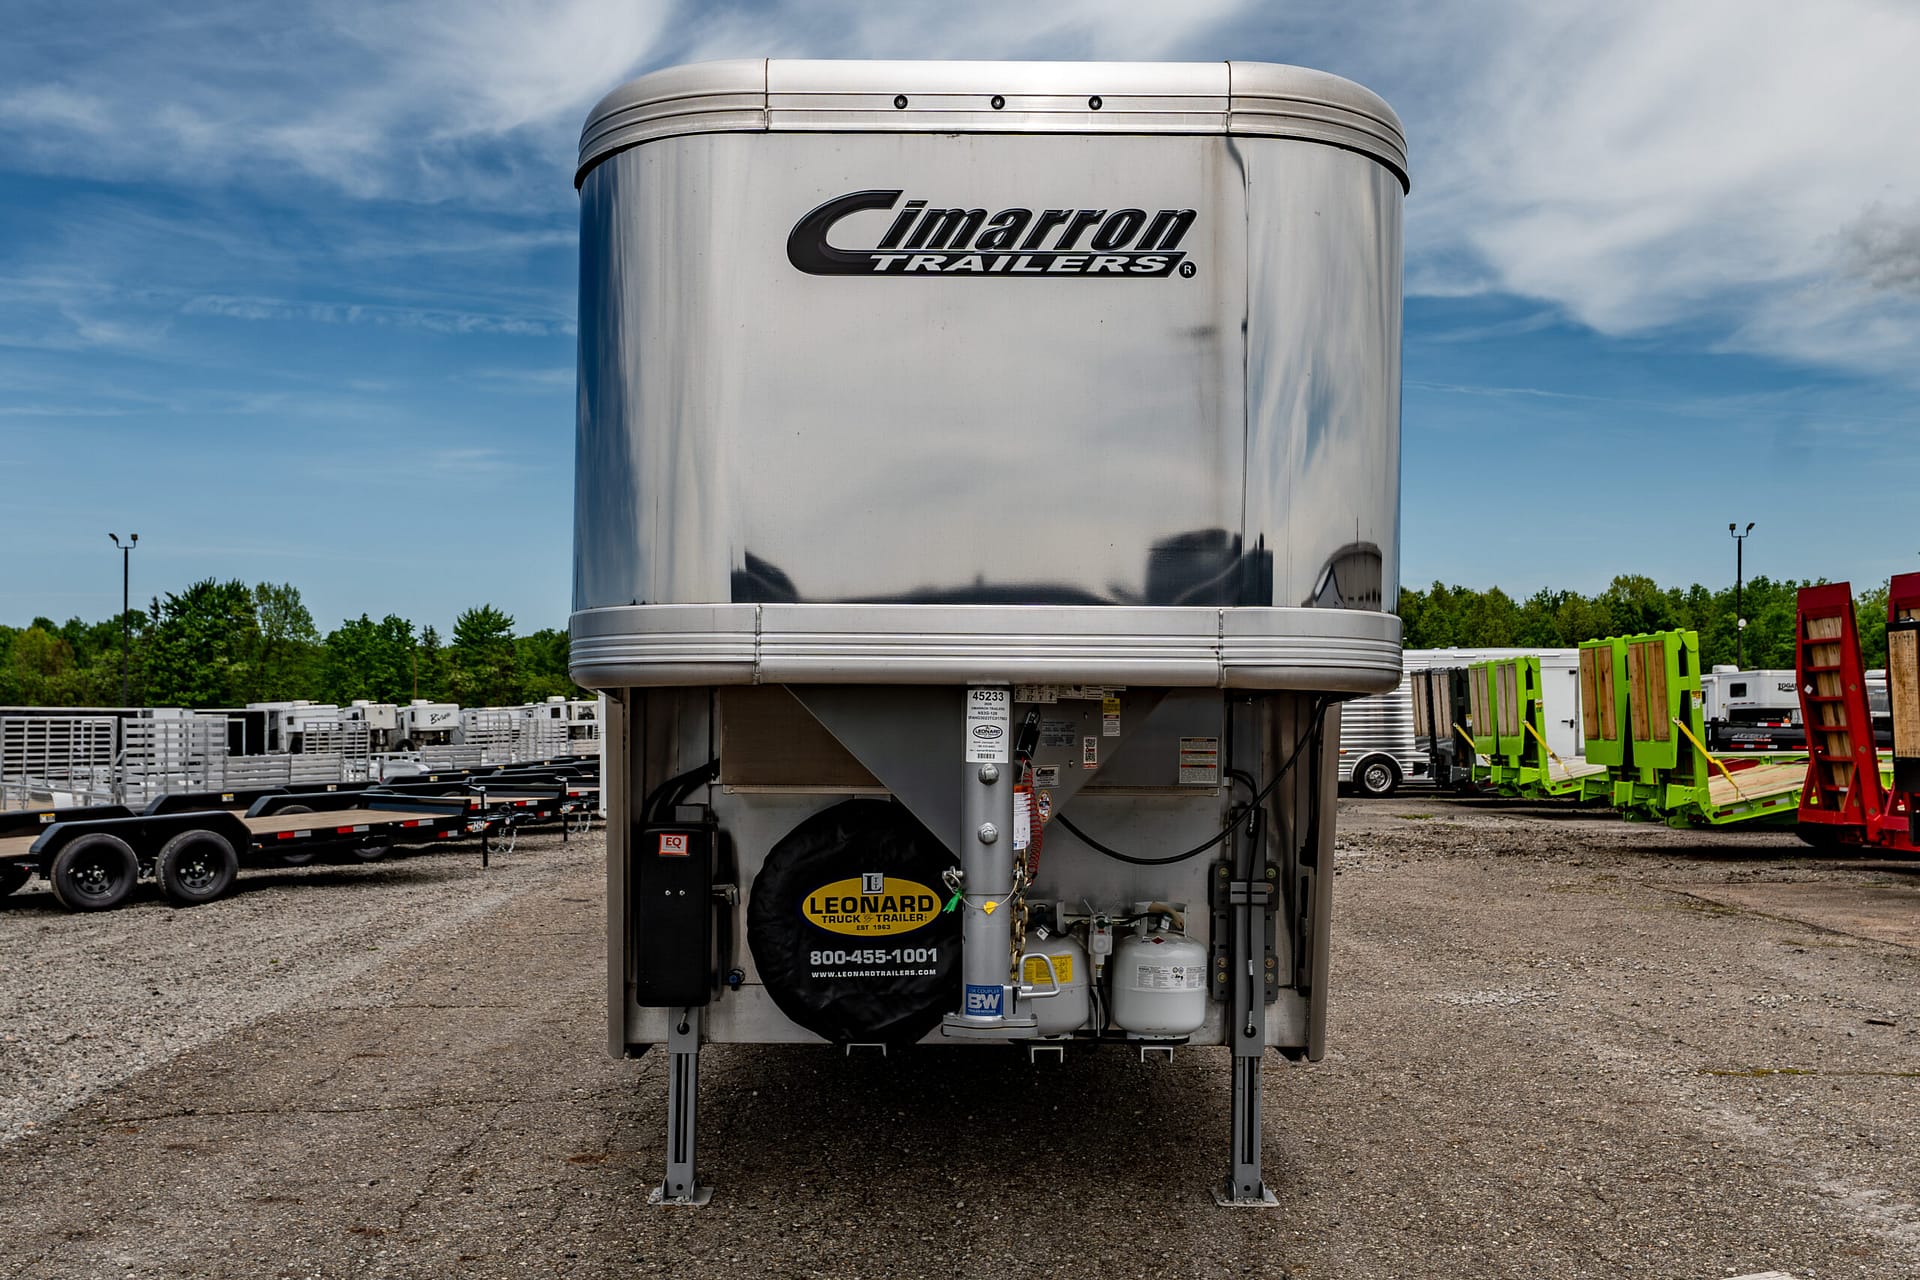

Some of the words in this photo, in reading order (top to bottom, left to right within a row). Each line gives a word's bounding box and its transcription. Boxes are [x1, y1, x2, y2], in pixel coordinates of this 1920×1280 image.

[787, 190, 1198, 276] Cimarron
[870, 254, 1170, 273] TRAILERS
[972, 691, 1004, 702] 45233
[665, 836, 682, 849] EQ
[810, 895, 934, 915] LEONARD
[821, 914, 861, 924] TRUCK
[876, 913, 924, 922] TRAILER
[810, 948, 938, 966] 800-455-1001
[811, 969, 937, 978] WWW.LEONARDTRAILERS.COM
